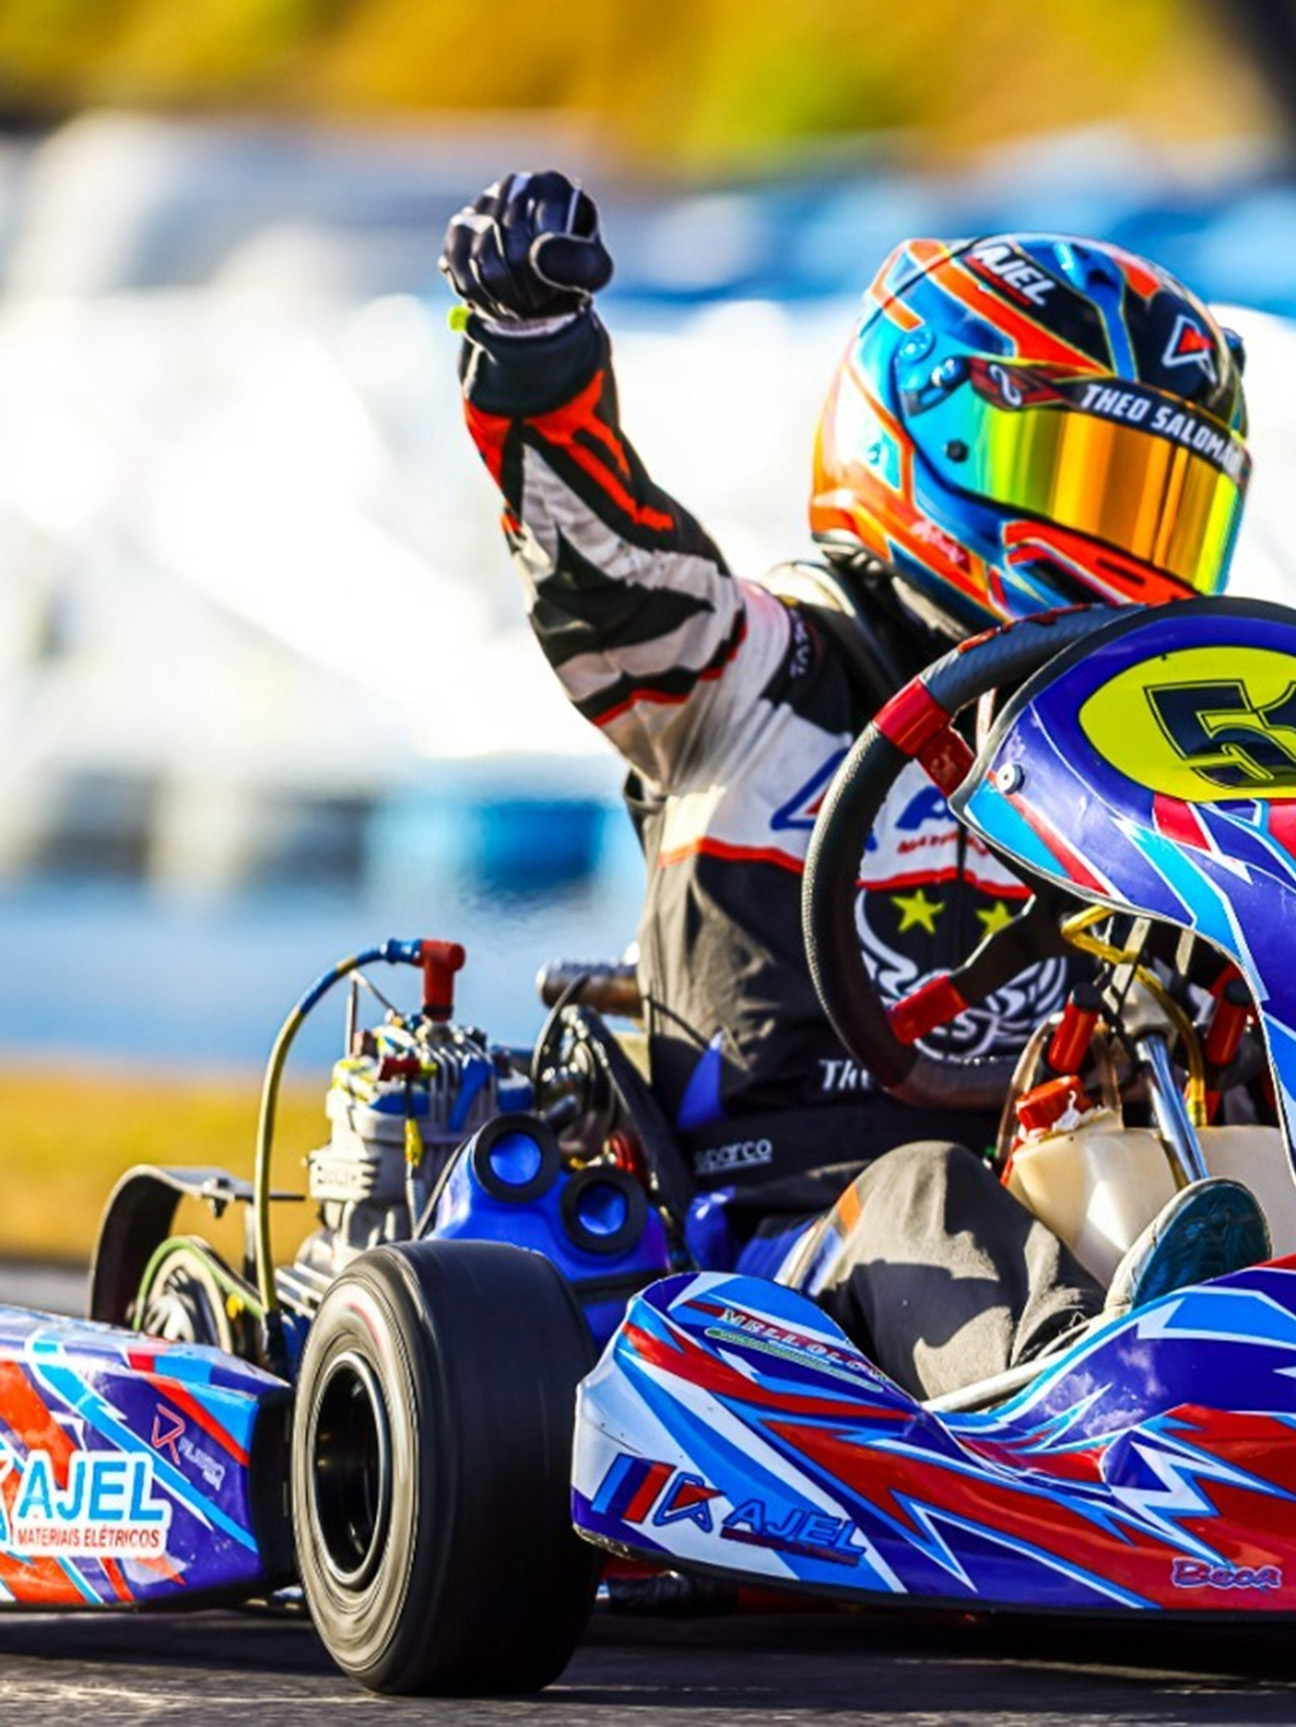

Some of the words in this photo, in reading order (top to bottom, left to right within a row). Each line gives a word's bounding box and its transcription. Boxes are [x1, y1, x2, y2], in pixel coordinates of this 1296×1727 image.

[970, 243, 1055, 306] AJEL
[1081, 384, 1151, 422] THEO
[695, 1139, 773, 1173] sparco
[17, 1460, 164, 1521] AJEL
[17, 1527, 79, 1547] MATERIAIS
[84, 1525, 160, 1547] ELÉTRICOS
[721, 1498, 867, 1556] AJEL
